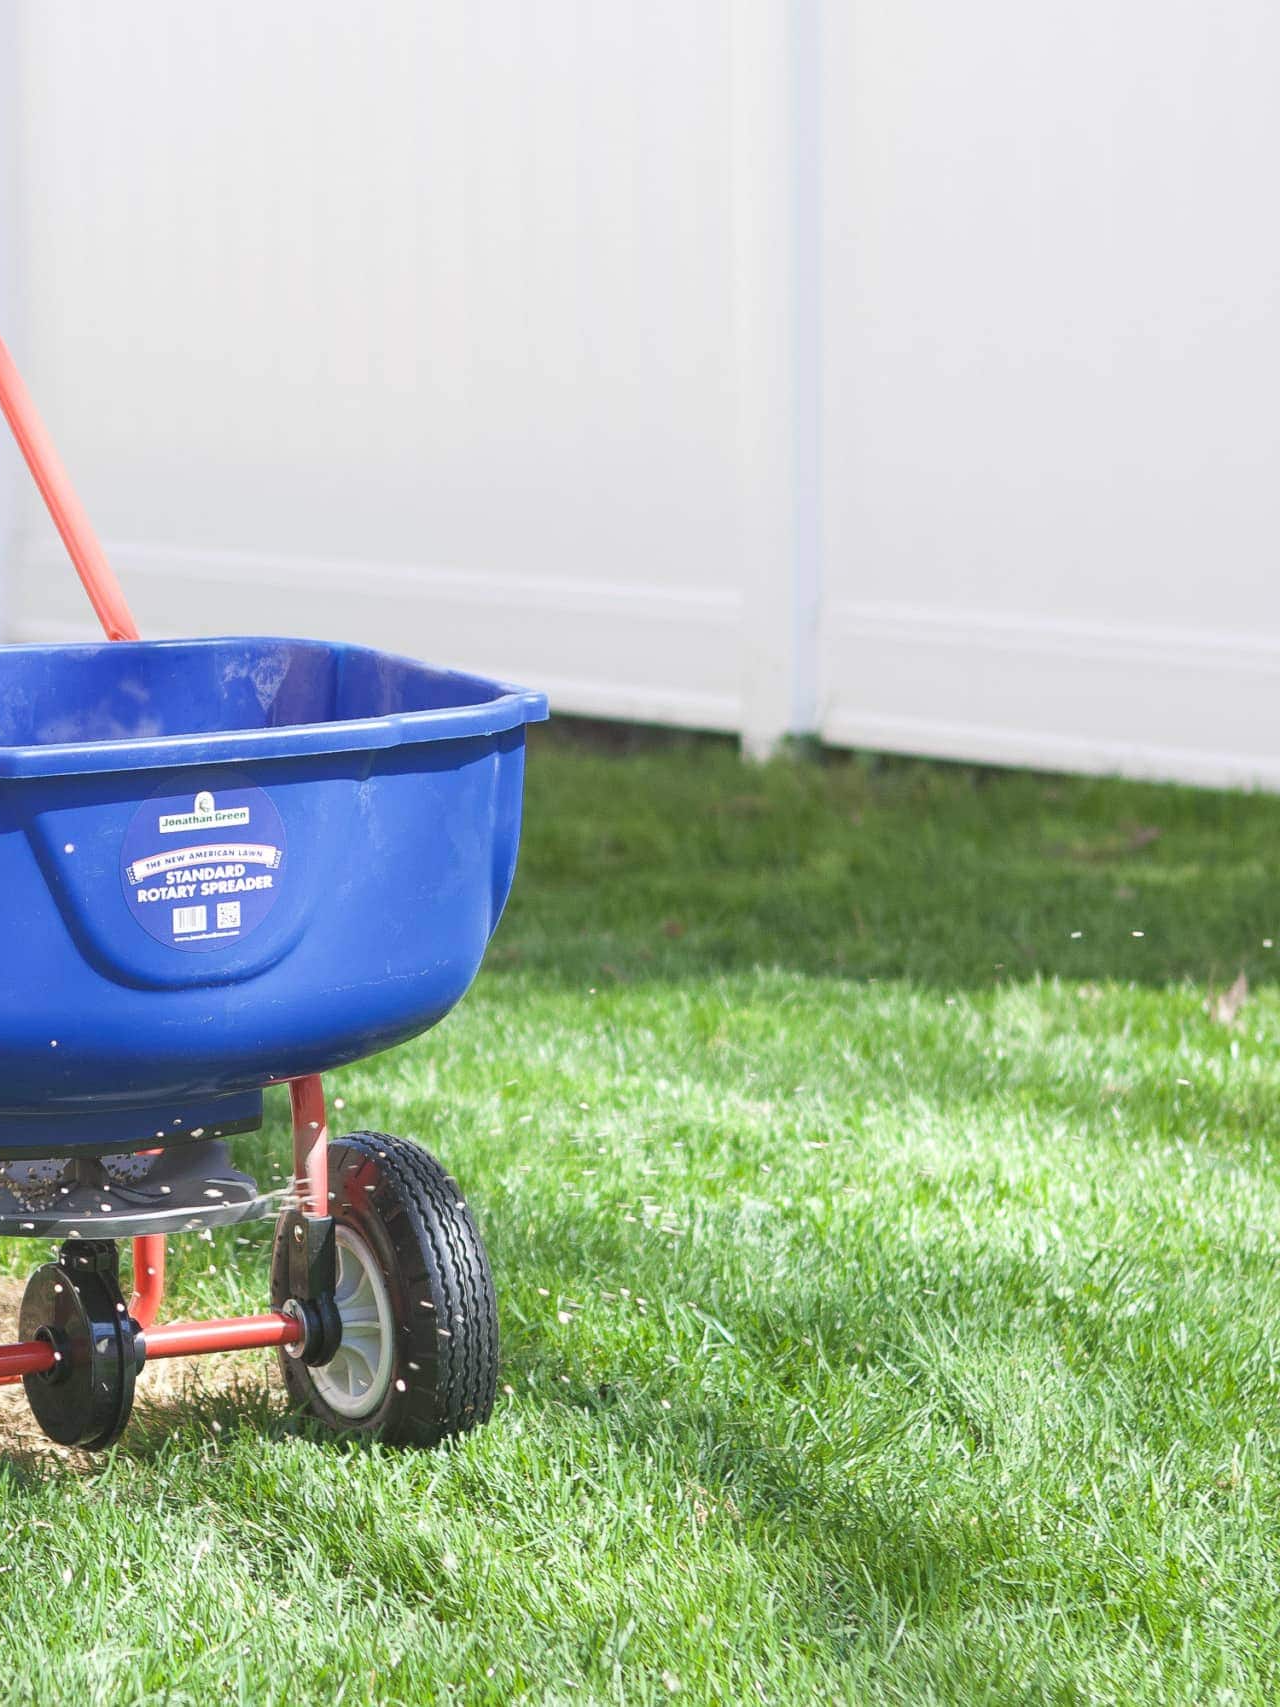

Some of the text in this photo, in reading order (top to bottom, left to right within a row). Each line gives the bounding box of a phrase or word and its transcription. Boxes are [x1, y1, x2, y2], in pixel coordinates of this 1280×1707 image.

[161, 811, 247, 828] Jonathan Green
[145, 849, 263, 871] THE NEW AMERICAN LAWN
[165, 863, 246, 886] STANDARD
[137, 875, 273, 903] ROTARY SPREADER
